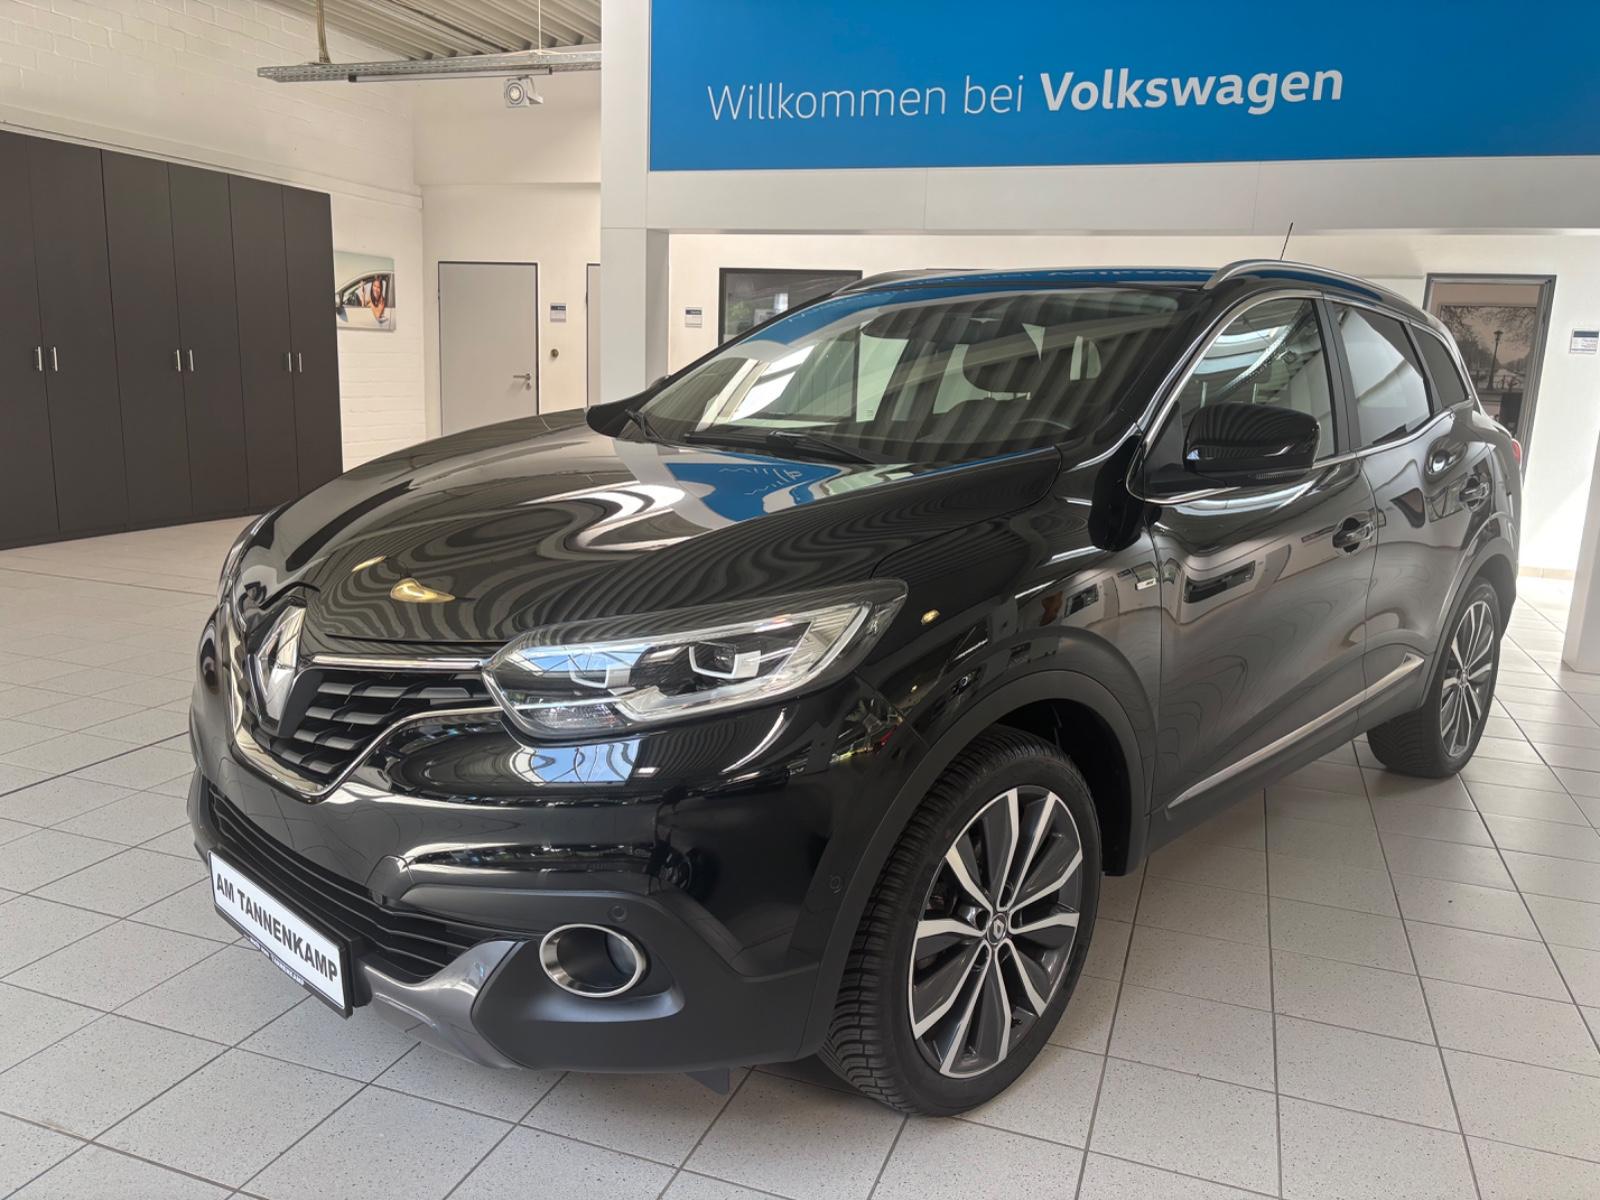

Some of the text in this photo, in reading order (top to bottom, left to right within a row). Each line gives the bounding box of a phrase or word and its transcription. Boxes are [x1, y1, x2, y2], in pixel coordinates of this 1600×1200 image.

[707, 67, 1343, 120] Willkommen bei Volkswagen
[216, 873, 235, 903] AM
[237, 888, 338, 982] TANNENKAMP
